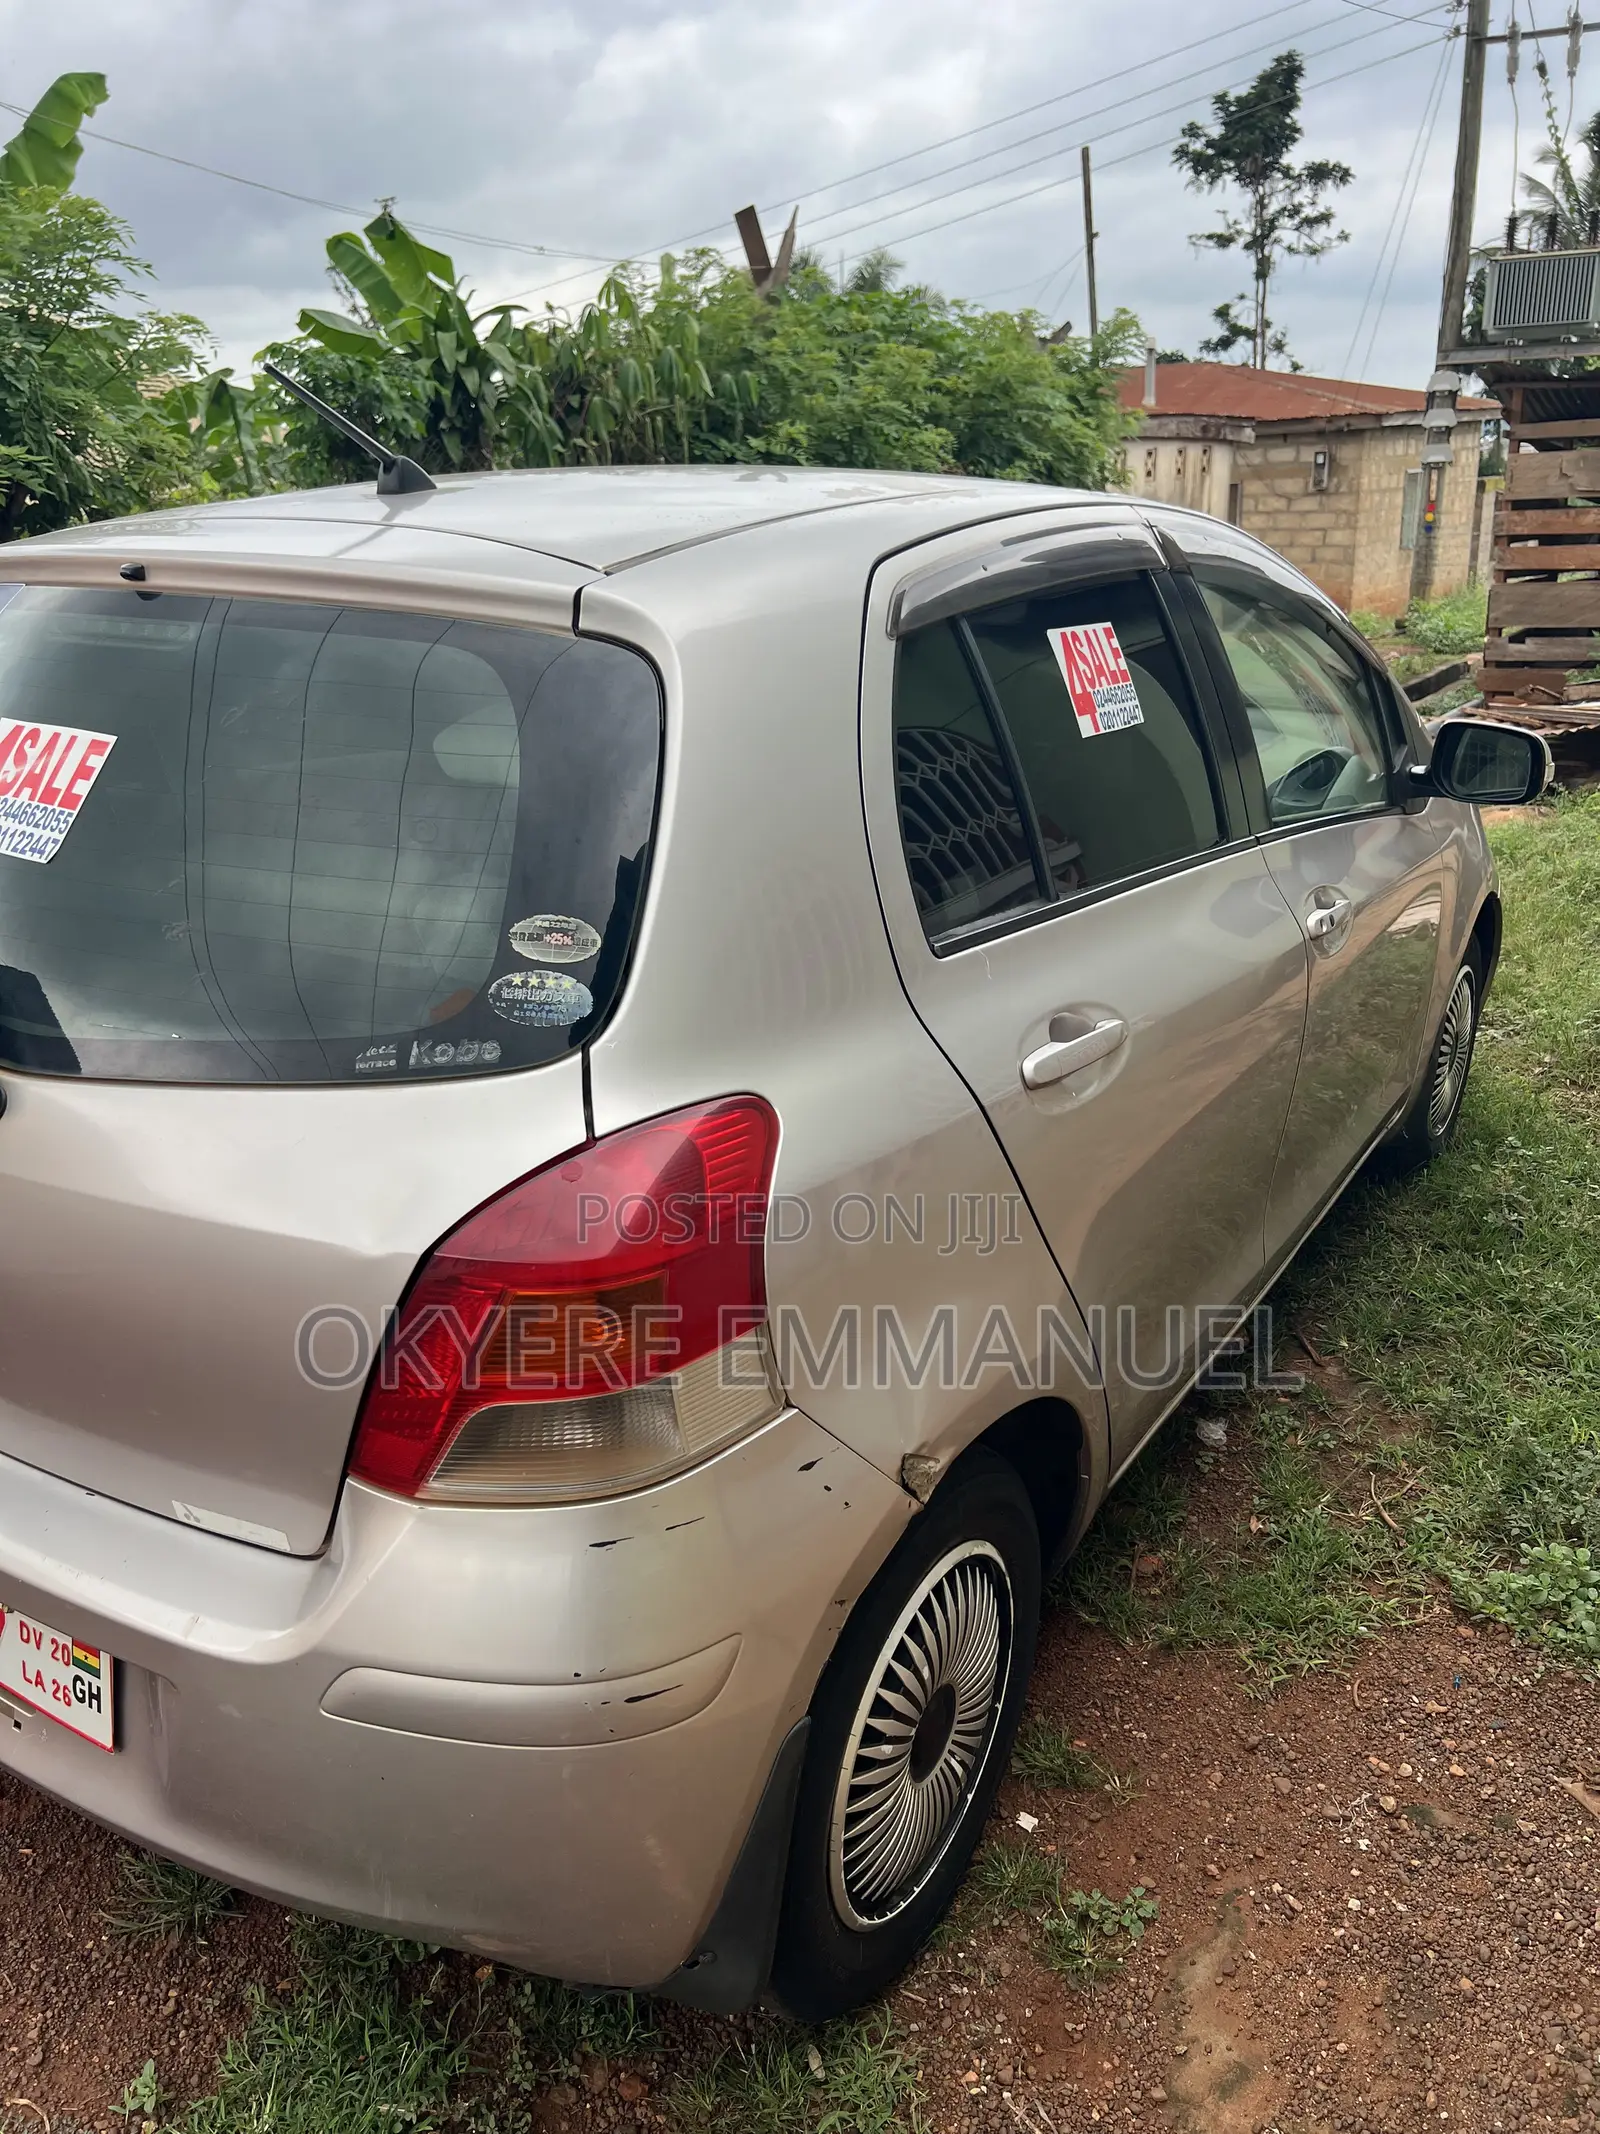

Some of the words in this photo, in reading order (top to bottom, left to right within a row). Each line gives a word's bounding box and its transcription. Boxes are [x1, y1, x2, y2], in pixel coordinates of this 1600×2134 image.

[1093, 683, 1137, 709] 0244662055
[1099, 704, 1142, 731] 0201122447
[409, 1039, 502, 1066] Kobe
[19, 1619, 43, 1651] DV
[51, 1637, 71, 1667] 20
[22, 1660, 47, 1693] LA
[52, 1678, 72, 1708] 26
[72, 1674, 102, 1714] GH
